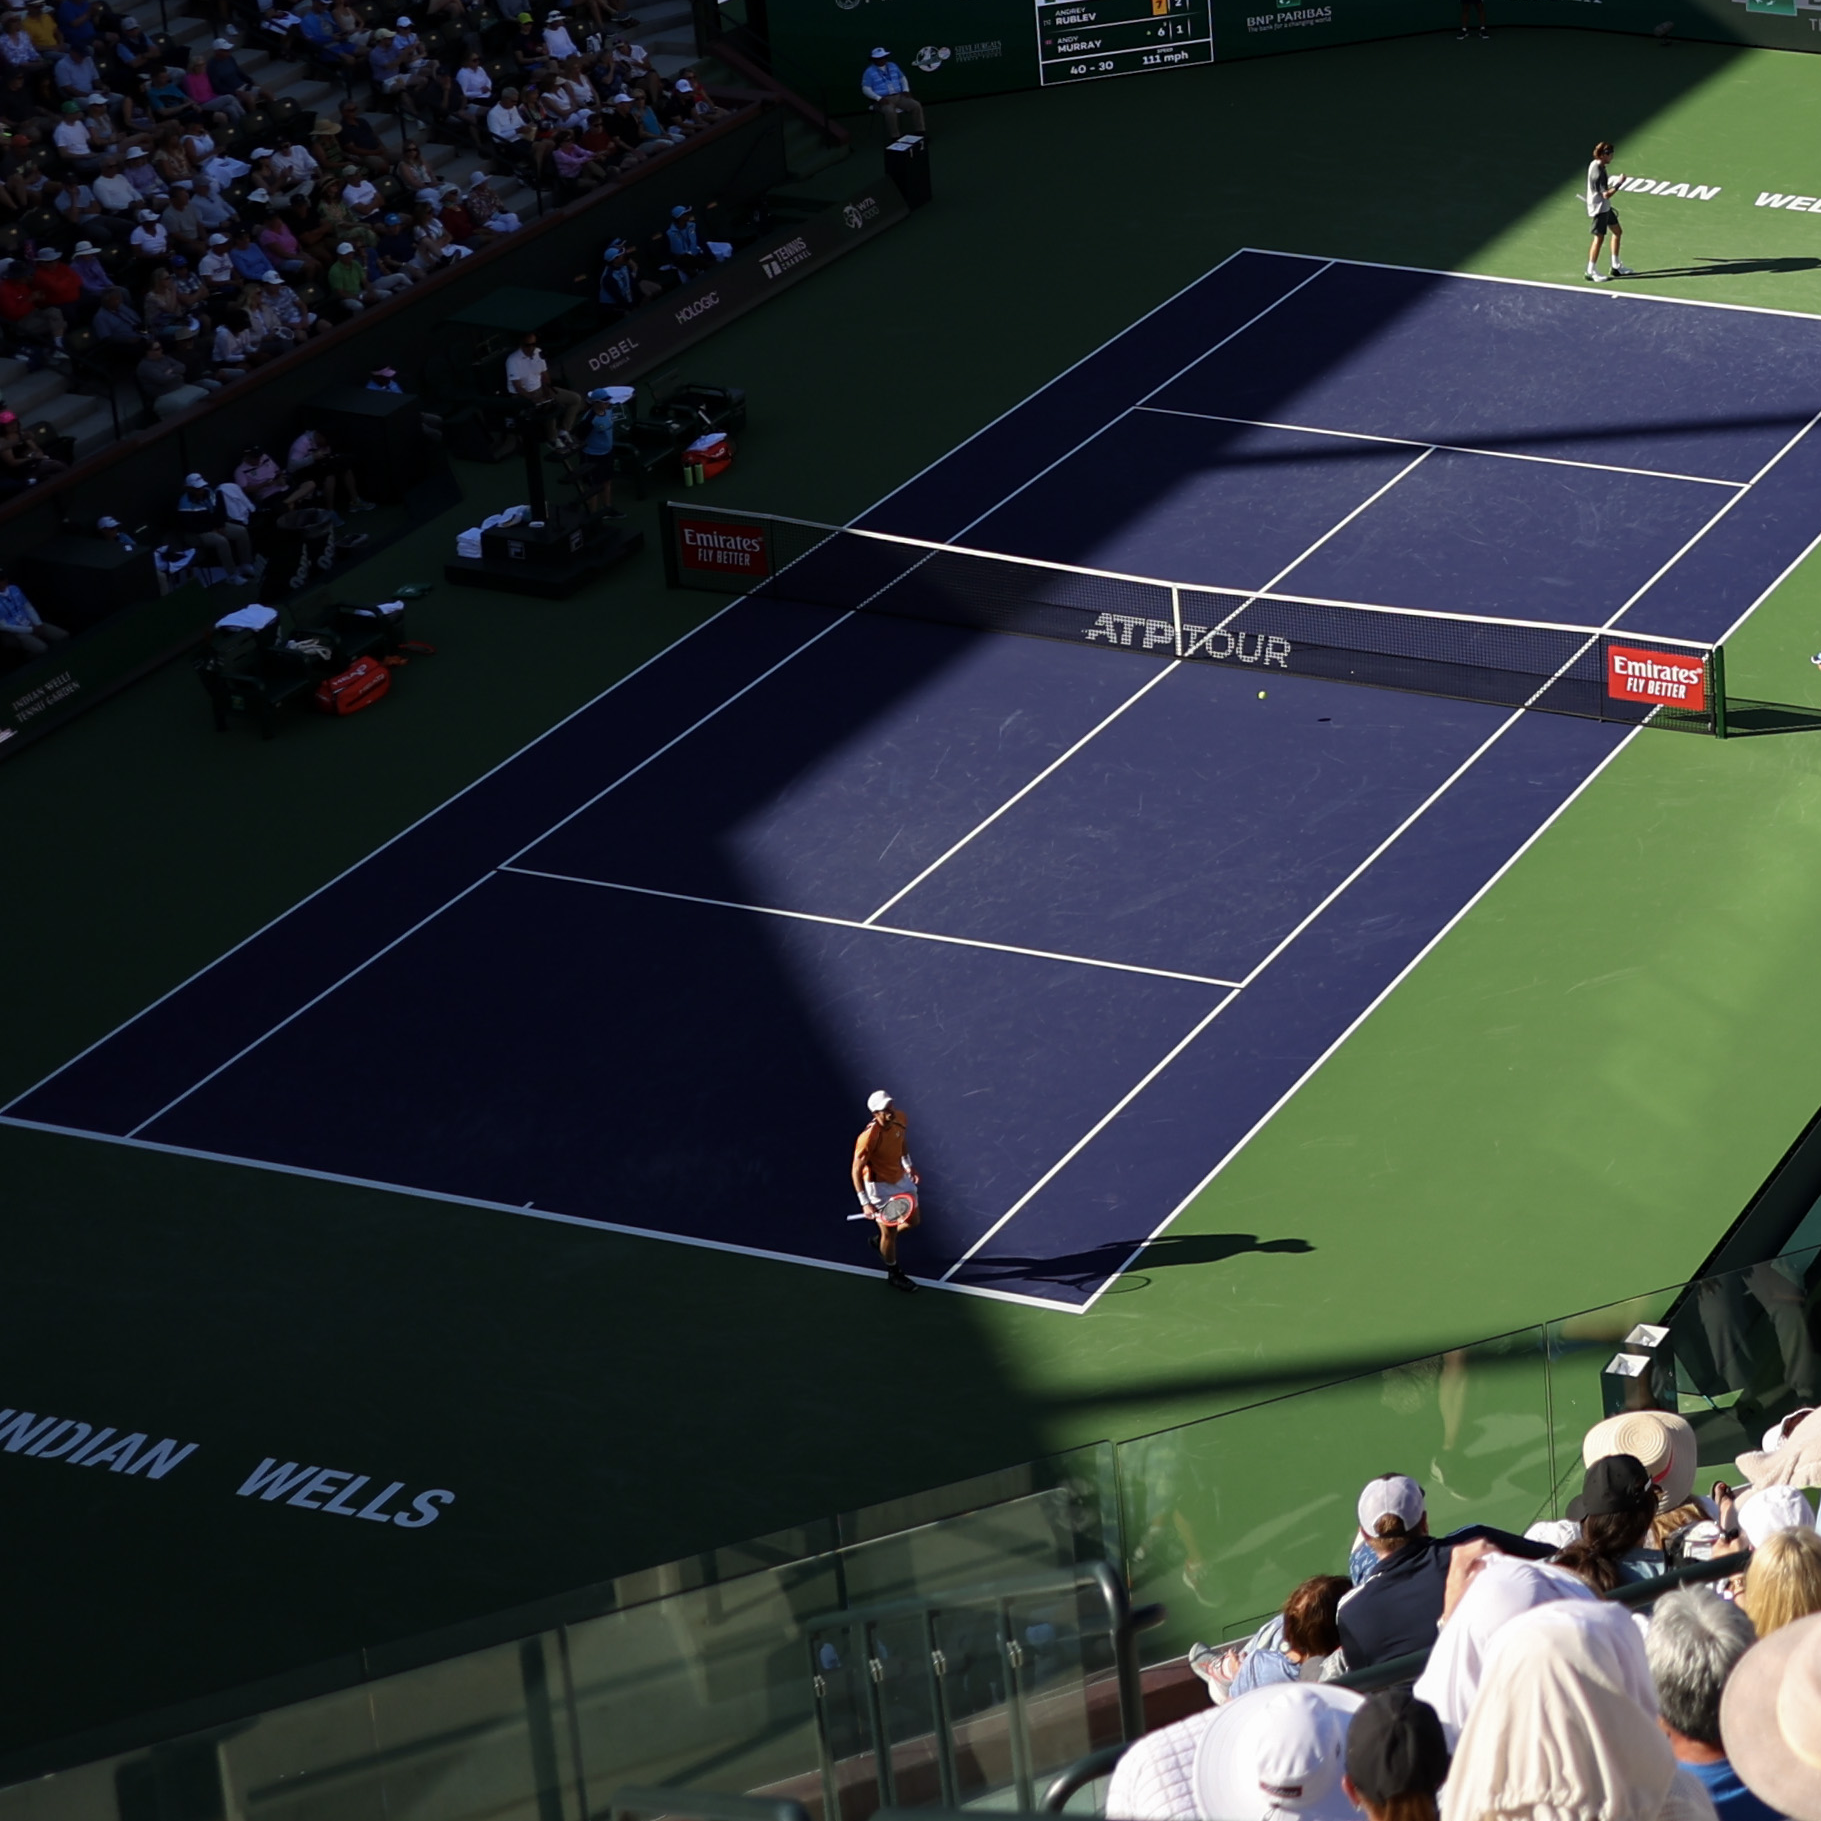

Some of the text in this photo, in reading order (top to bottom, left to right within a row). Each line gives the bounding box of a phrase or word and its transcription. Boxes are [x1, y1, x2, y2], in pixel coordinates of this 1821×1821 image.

[1055, 7, 1086, 17] ANDREY
[1055, 12, 1097, 26] RUBLEV
[1246, 6, 1332, 27] BNP PARIBAS
[1057, 35, 1079, 44] ANDY
[1176, 25, 1184, 34] 1
[1057, 39, 1102, 54] MURRAY
[1070, 64, 1087, 75] 40
[1099, 60, 1114, 71] 30
[1142, 50, 1189, 65] 111 mph
[773, 237, 807, 262] TENNIS
[674, 290, 720, 324] HOLOGIC
[588, 337, 639, 371] DOBEL
[683, 528, 761, 552] Emirates
[698, 548, 750, 567] FLY BETTER
[1081, 612, 1290, 668] ATP TOUR
[1613, 655, 1700, 685] Emirates
[1626, 677, 1686, 699] FLY BETTER
[235, 1457, 456, 1528] WELLS
